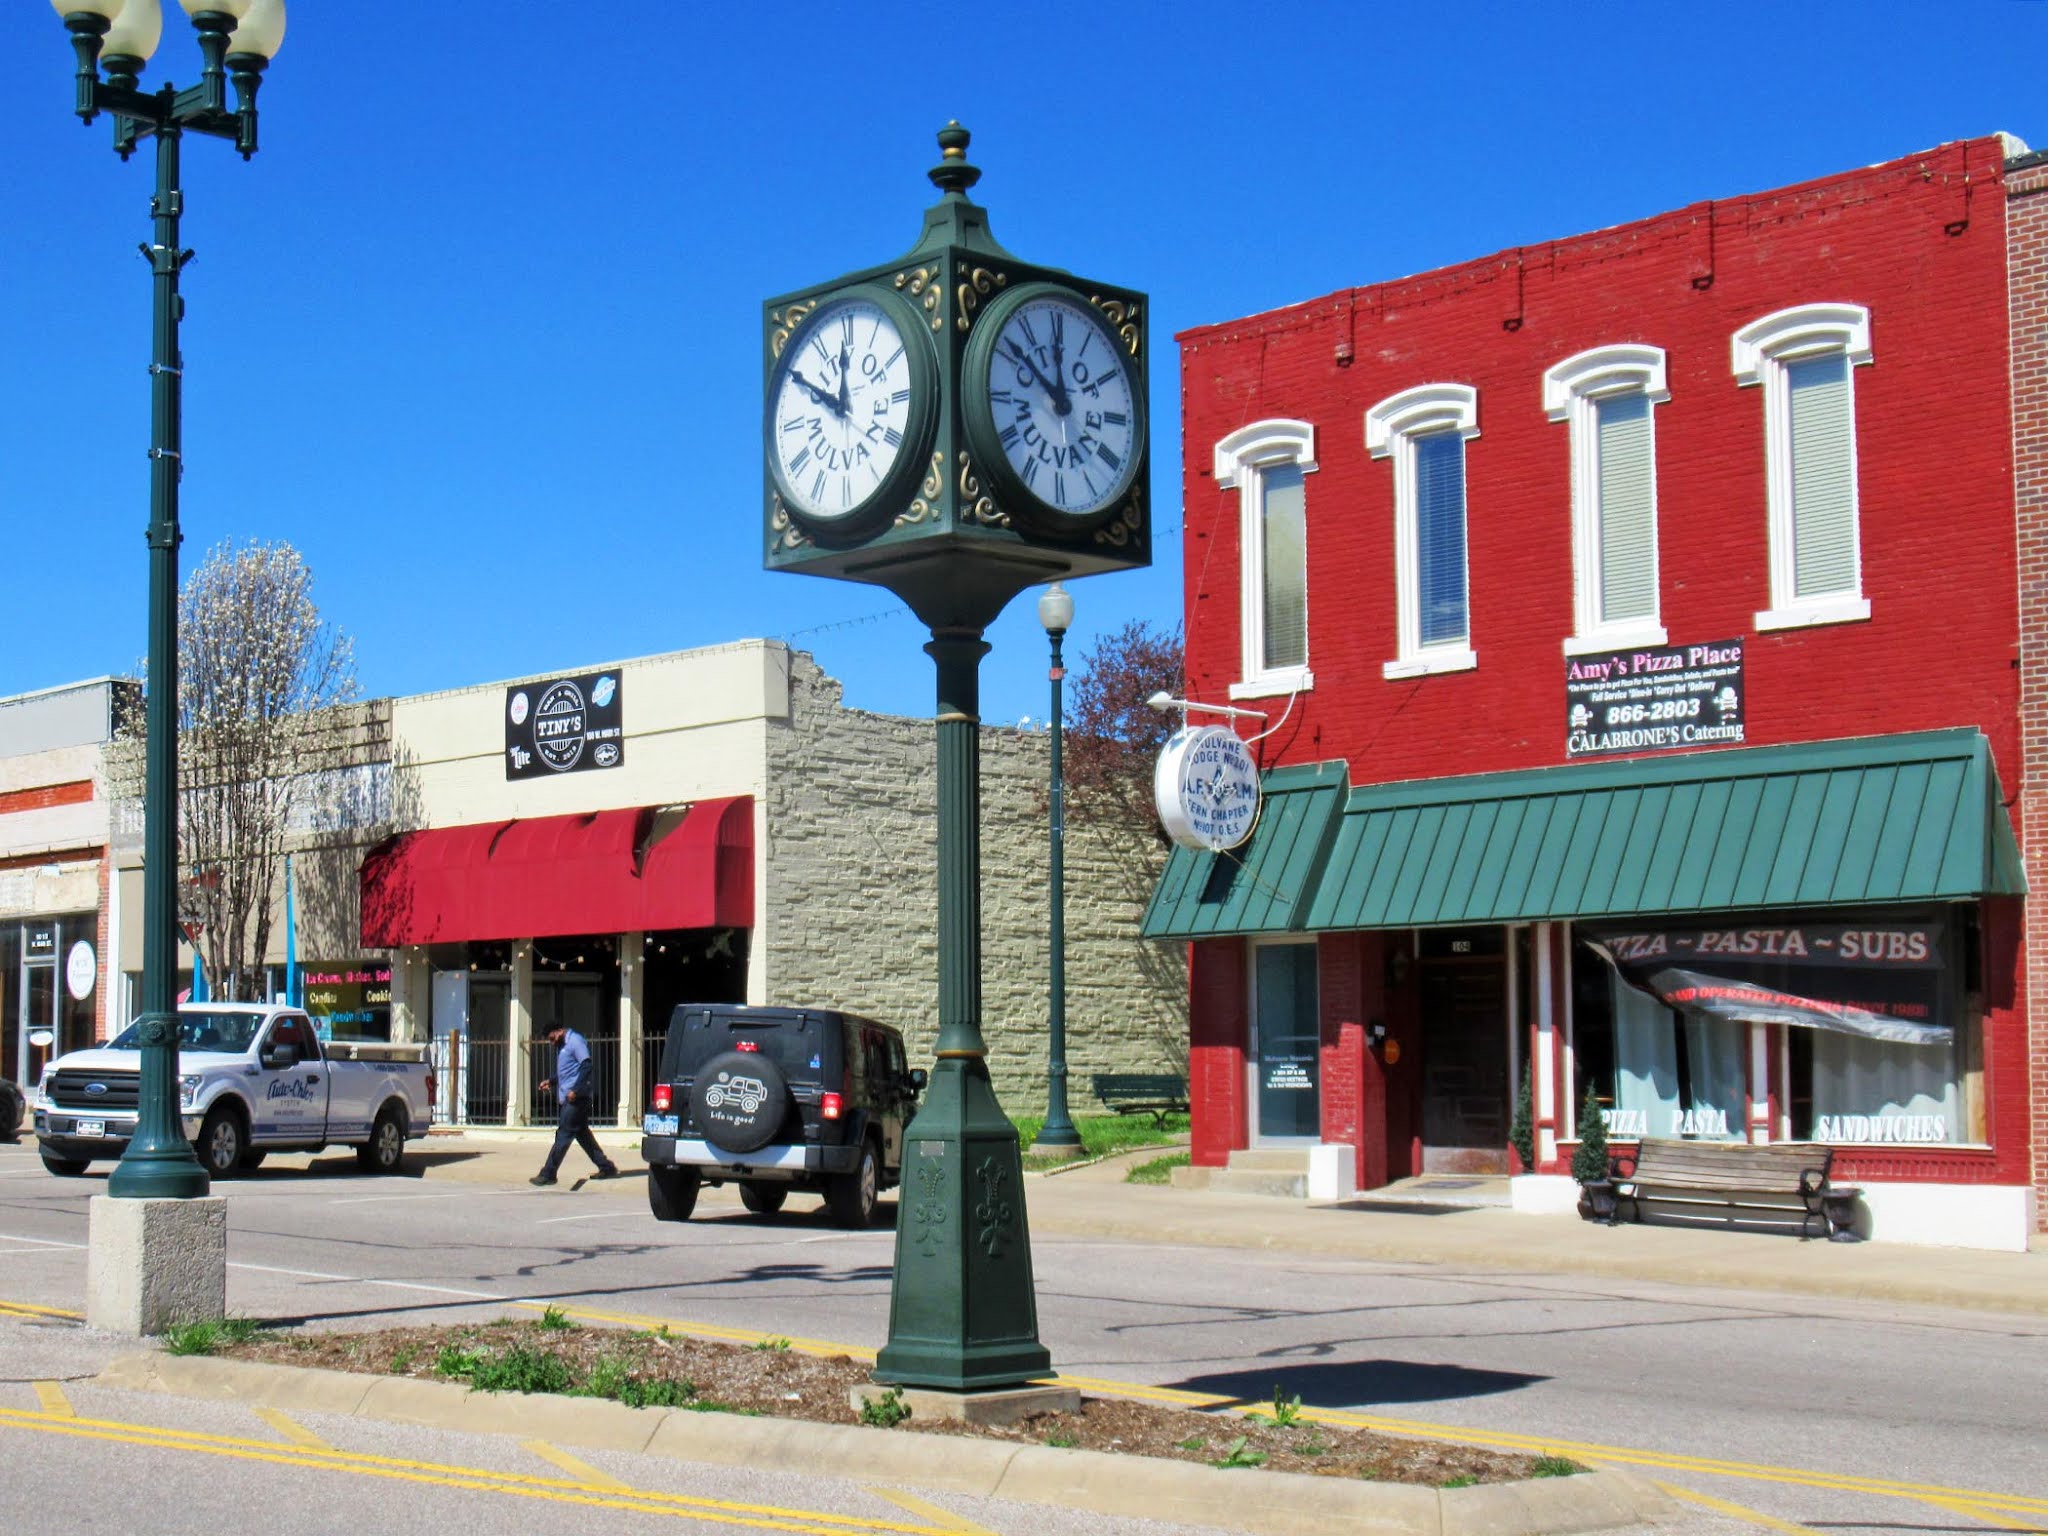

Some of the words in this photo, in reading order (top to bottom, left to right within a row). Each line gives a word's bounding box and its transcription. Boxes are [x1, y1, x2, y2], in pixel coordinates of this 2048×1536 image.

[861, 353, 888, 388] OF
[1016, 343, 1066, 388] CT
[1072, 361, 1100, 400] OF
[807, 398, 889, 471] MULVANE
[1013, 398, 1102, 470] MULVANE
[1568, 656, 1628, 682] Amy's
[1632, 653, 1684, 674] Pizza
[1688, 646, 1742, 667] Place
[1592, 691, 1604, 702] Full
[1604, 689, 1627, 701] Service
[1674, 683, 1686, 693] Out
[1606, 698, 1701, 725] 866-2803
[538, 716, 582, 737] TINY'S
[1568, 726, 1680, 753] CALABRONE'S
[1683, 723, 1744, 742] Catering
[514, 750, 531, 769] Lite
[1187, 750, 1219, 766] LODGE
[1182, 777, 1205, 795] A.F.
[1211, 804, 1249, 820] CHAPTER
[1696, 929, 1809, 956] PASTA
[1839, 931, 1929, 961] SUBS
[267, 1078, 314, 1104] Auto-Chlor
[710, 1110, 726, 1120] Life
[734, 1116, 754, 1126] good
[1600, 1109, 1648, 1135] PIZZA
[1670, 1109, 1728, 1135] PASTA
[1817, 1114, 1946, 1143] SANDWICHES
